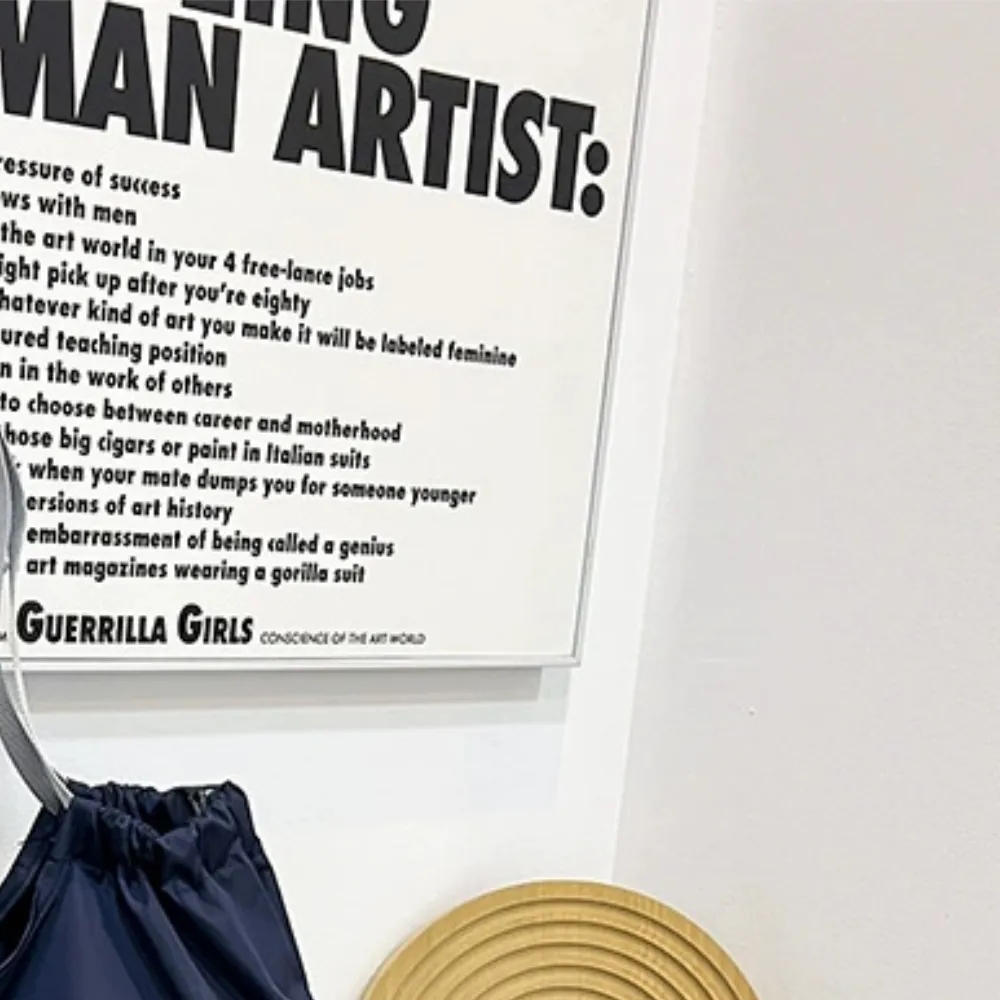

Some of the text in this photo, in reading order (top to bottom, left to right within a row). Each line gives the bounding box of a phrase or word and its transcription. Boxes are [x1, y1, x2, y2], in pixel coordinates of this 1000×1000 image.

[273, 44, 608, 217] ARTIST:
[81, 164, 103, 188] of
[109, 174, 181, 200] success
[37, 193, 86, 219] with
[93, 205, 137, 226] men
[0, 219, 36, 247] the
[42, 231, 75, 251] art
[81, 235, 142, 260] world
[147, 239, 166, 264] in
[173, 250, 218, 271] your
[223, 251, 236, 273] 4
[242, 252, 333, 286] free-lance
[337, 265, 375, 293] jobs
[47, 260, 89, 289] pick
[96, 272, 121, 296] up
[127, 271, 178, 297] after
[184, 282, 246, 306] you're
[251, 286, 311, 319] eighty
[57, 330, 143, 364] teaching
[148, 340, 227, 367] position
[87, 297, 133, 325] kind
[138, 305, 160, 327] of
[165, 312, 195, 332] art
[201, 317, 236, 340] you
[241, 319, 292, 343] make
[297, 322, 312, 345] it
[316, 326, 351, 349] will
[355, 329, 377, 352] be
[381, 332, 444, 359] labeled
[448, 340, 517, 368] feminine
[19, 356, 39, 381] in
[47, 359, 81, 385] the
[87, 367, 139, 391] work
[145, 370, 166, 393] of
[171, 373, 233, 399] others
[0, 392, 21, 413] to
[27, 392, 96, 418] choose
[102, 397, 188, 426] between
[193, 412, 253, 431] career
[257, 413, 292, 434] and
[296, 417, 402, 443] motherhood
[4, 421, 53, 448] hose
[59, 426, 91, 457] big
[97, 429, 155, 459] cigars
[161, 441, 183, 457] or
[187, 438, 238, 464] paint
[243, 440, 261, 462] in
[266, 443, 325, 467] Italian
[329, 447, 370, 470] suits
[28, 457, 84, 482] when
[91, 467, 136, 489] your
[141, 468, 191, 488] mate
[197, 467, 257, 497] dumps
[263, 478, 296, 498] you
[301, 473, 327, 496] for
[332, 482, 406, 500] someone
[411, 487, 476, 509] younger
[26, 490, 99, 514] ersions
[104, 493, 127, 516] of
[131, 499, 161, 517] art
[166, 496, 233, 526] history
[26, 522, 181, 549] embarrassment
[187, 528, 207, 550] of
[212, 529, 263, 558] being
[267, 532, 319, 554] called
[323, 540, 335, 555] a
[339, 535, 394, 561] genius
[26, 556, 57, 575] art
[63, 556, 168, 583] magazines
[174, 559, 249, 586] wearing
[254, 566, 266, 581] a
[270, 562, 329, 588] gorilla
[333, 563, 365, 583] suit
[16, 599, 254, 645] GUERRILLA GIRLS
